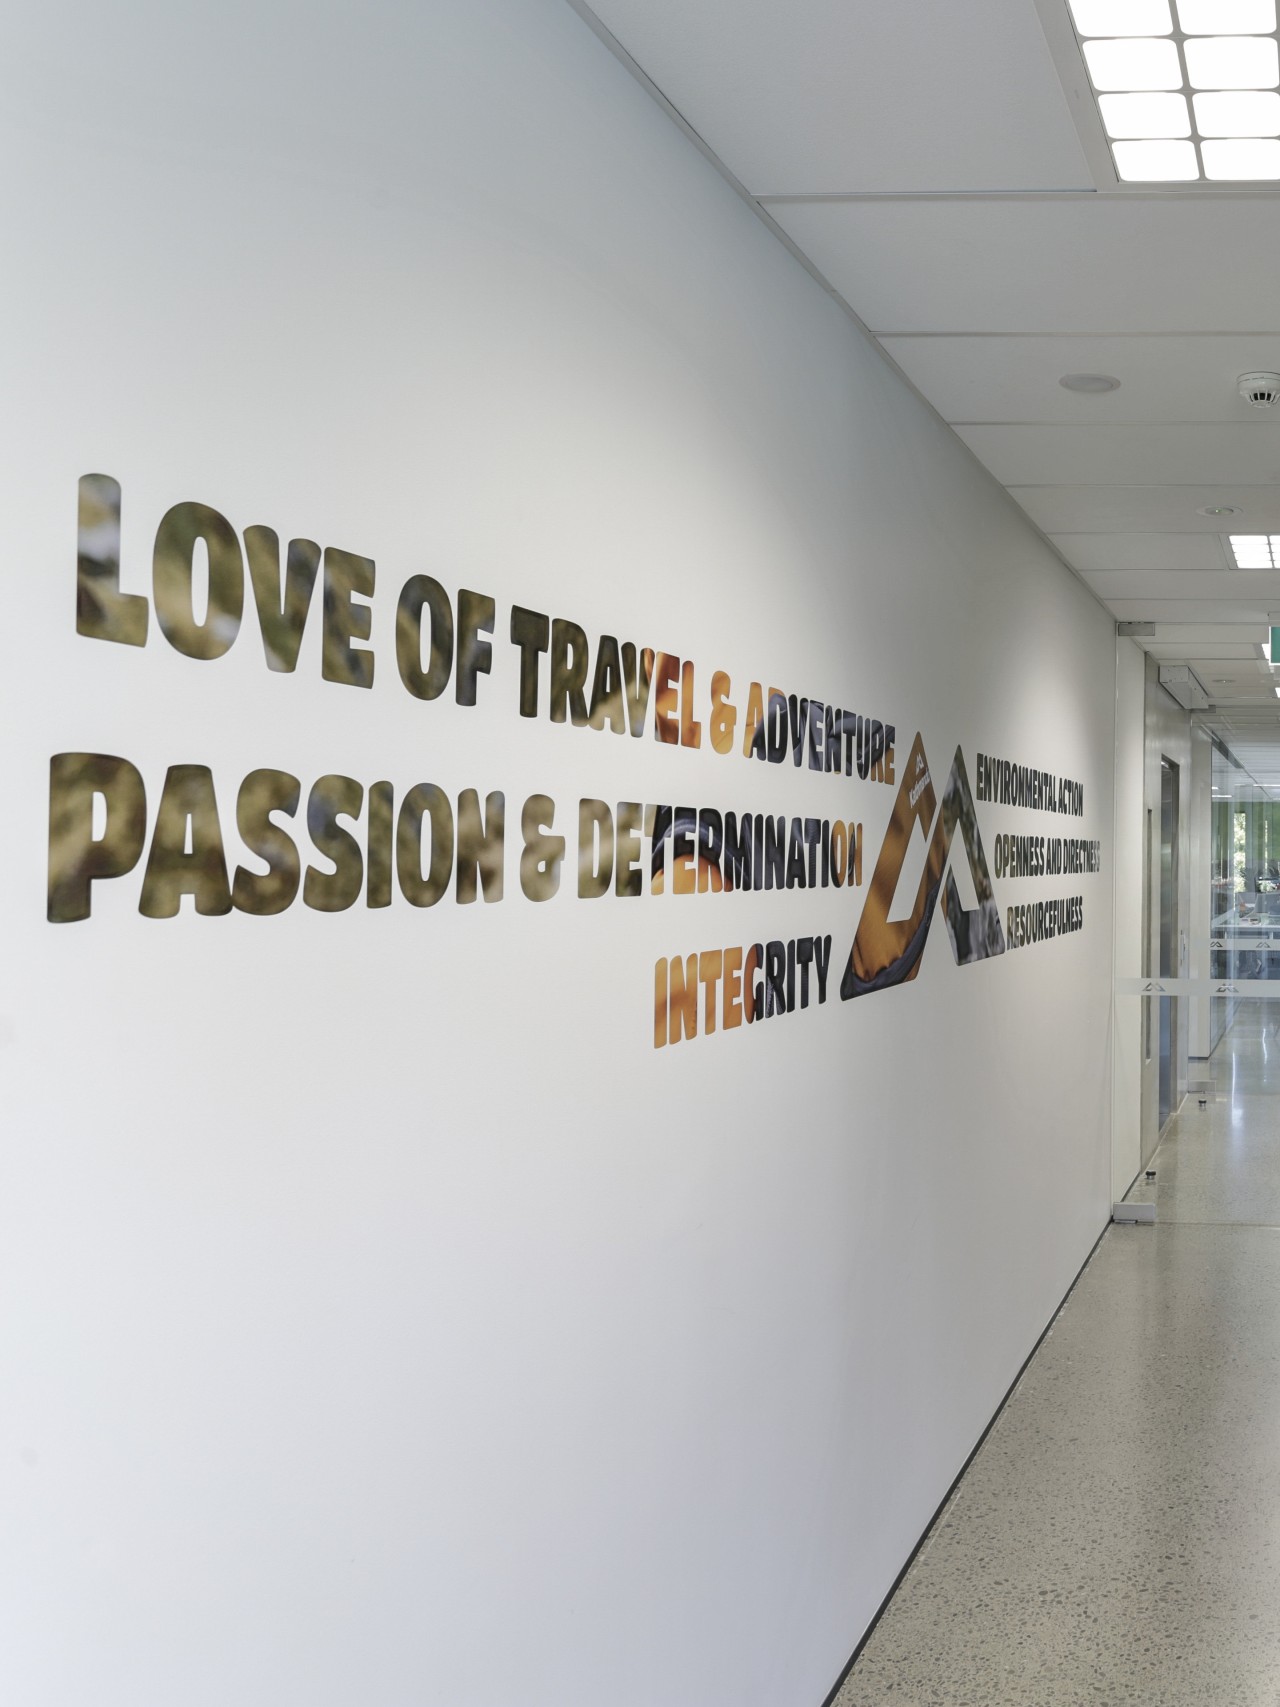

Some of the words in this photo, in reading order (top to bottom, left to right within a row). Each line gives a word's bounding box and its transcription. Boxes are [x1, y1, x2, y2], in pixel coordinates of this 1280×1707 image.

[76, 472, 376, 689] LOVE
[395, 574, 496, 706] OF
[510, 604, 701, 750] TRAVEL
[710, 670, 738, 755] &
[742, 682, 896, 786] ADVENTURE
[976, 752, 1057, 813] ENVIRONMENTAL
[1058, 777, 1084, 817] ACTION
[46, 751, 506, 924] PASSION
[520, 794, 566, 903] &
[577, 797, 863, 899] DETERMINATION
[994, 833, 1045, 879] OPENNESS
[1046, 837, 1062, 875] AND
[1063, 838, 1101, 874] DIRECTNESS
[1006, 896, 1083, 950] RESOURCEFULNESS
[654, 935, 832, 1049] INTEGRITY
